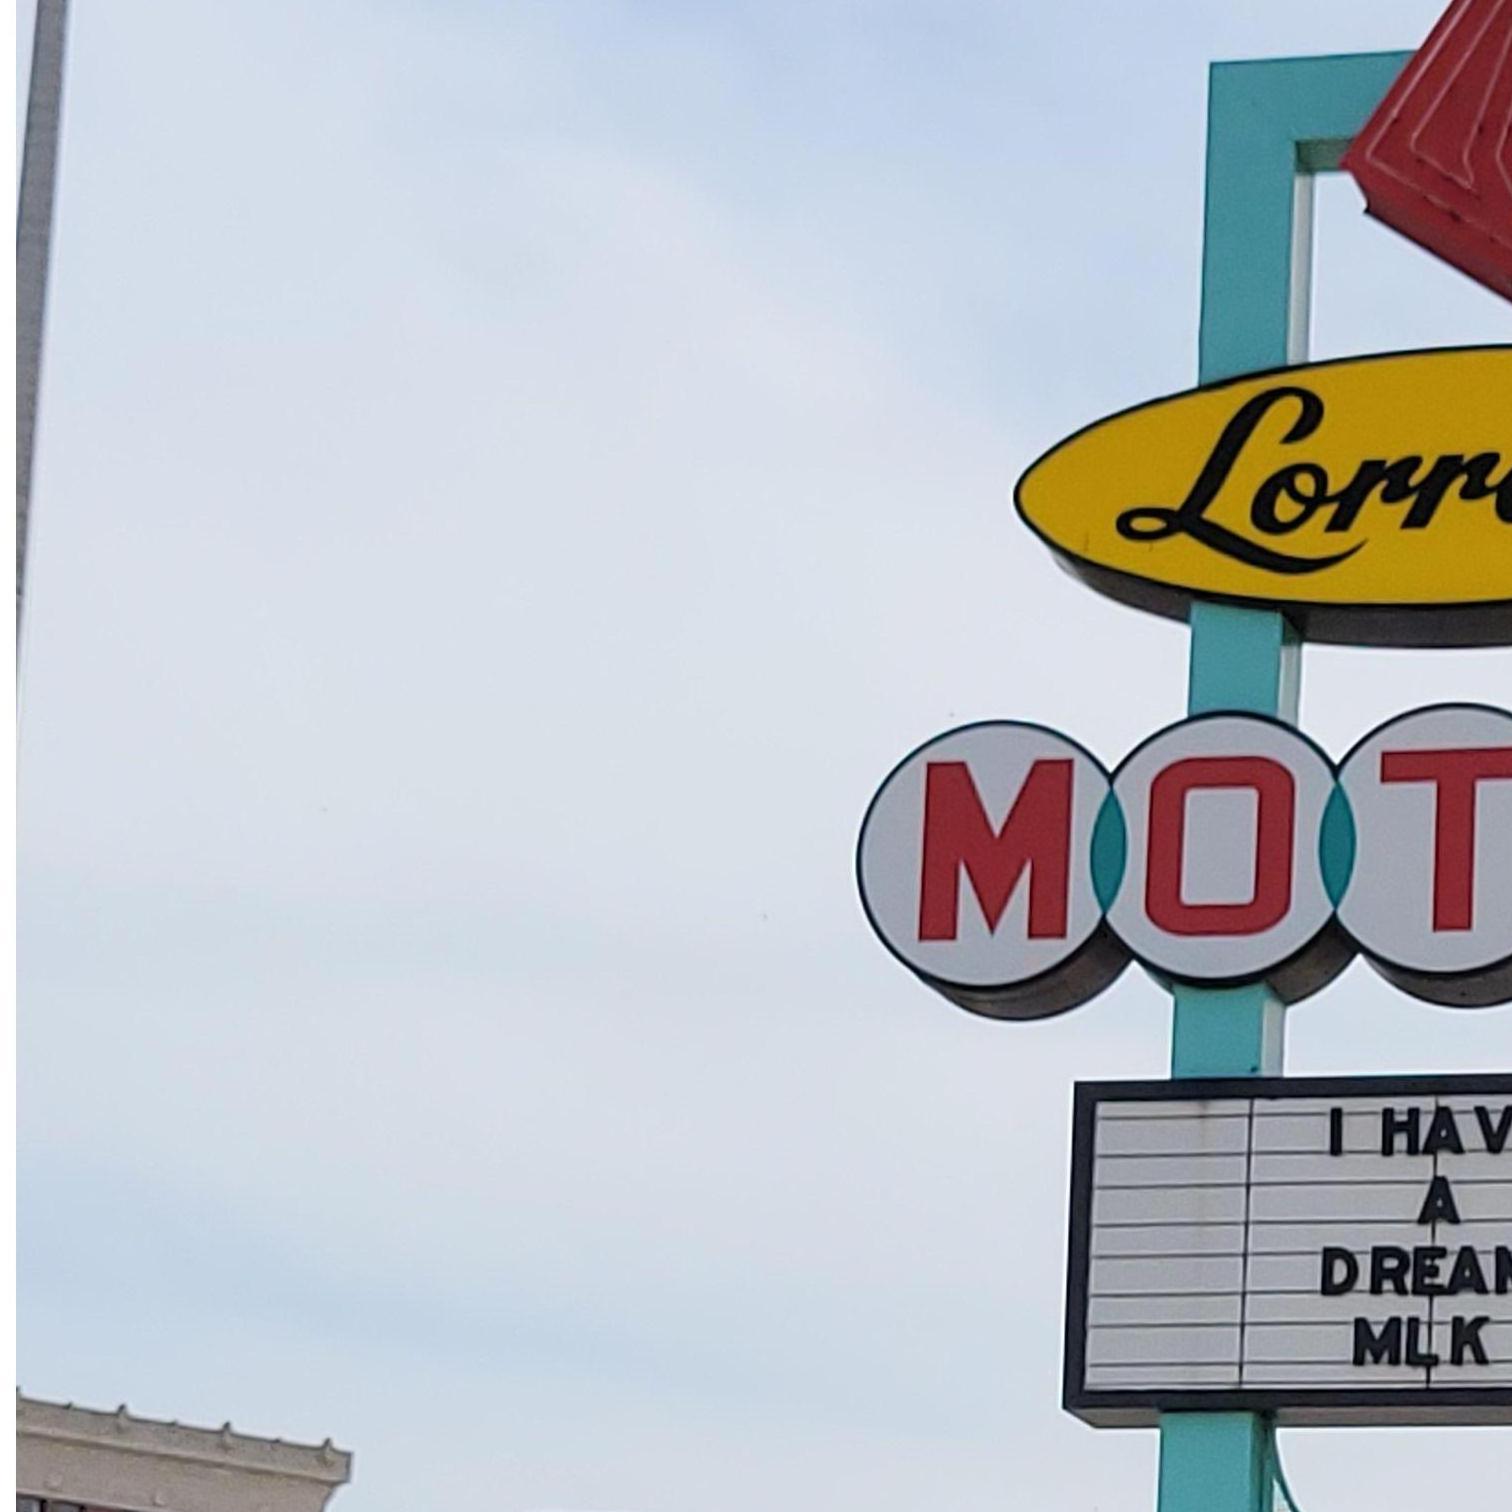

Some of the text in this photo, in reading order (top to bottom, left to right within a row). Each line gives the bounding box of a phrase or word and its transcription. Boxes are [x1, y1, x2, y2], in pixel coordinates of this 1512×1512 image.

[1329, 1107, 1343, 1156] I
[1418, 1176, 1461, 1225] A
[1353, 1316, 1490, 1366] MLK
